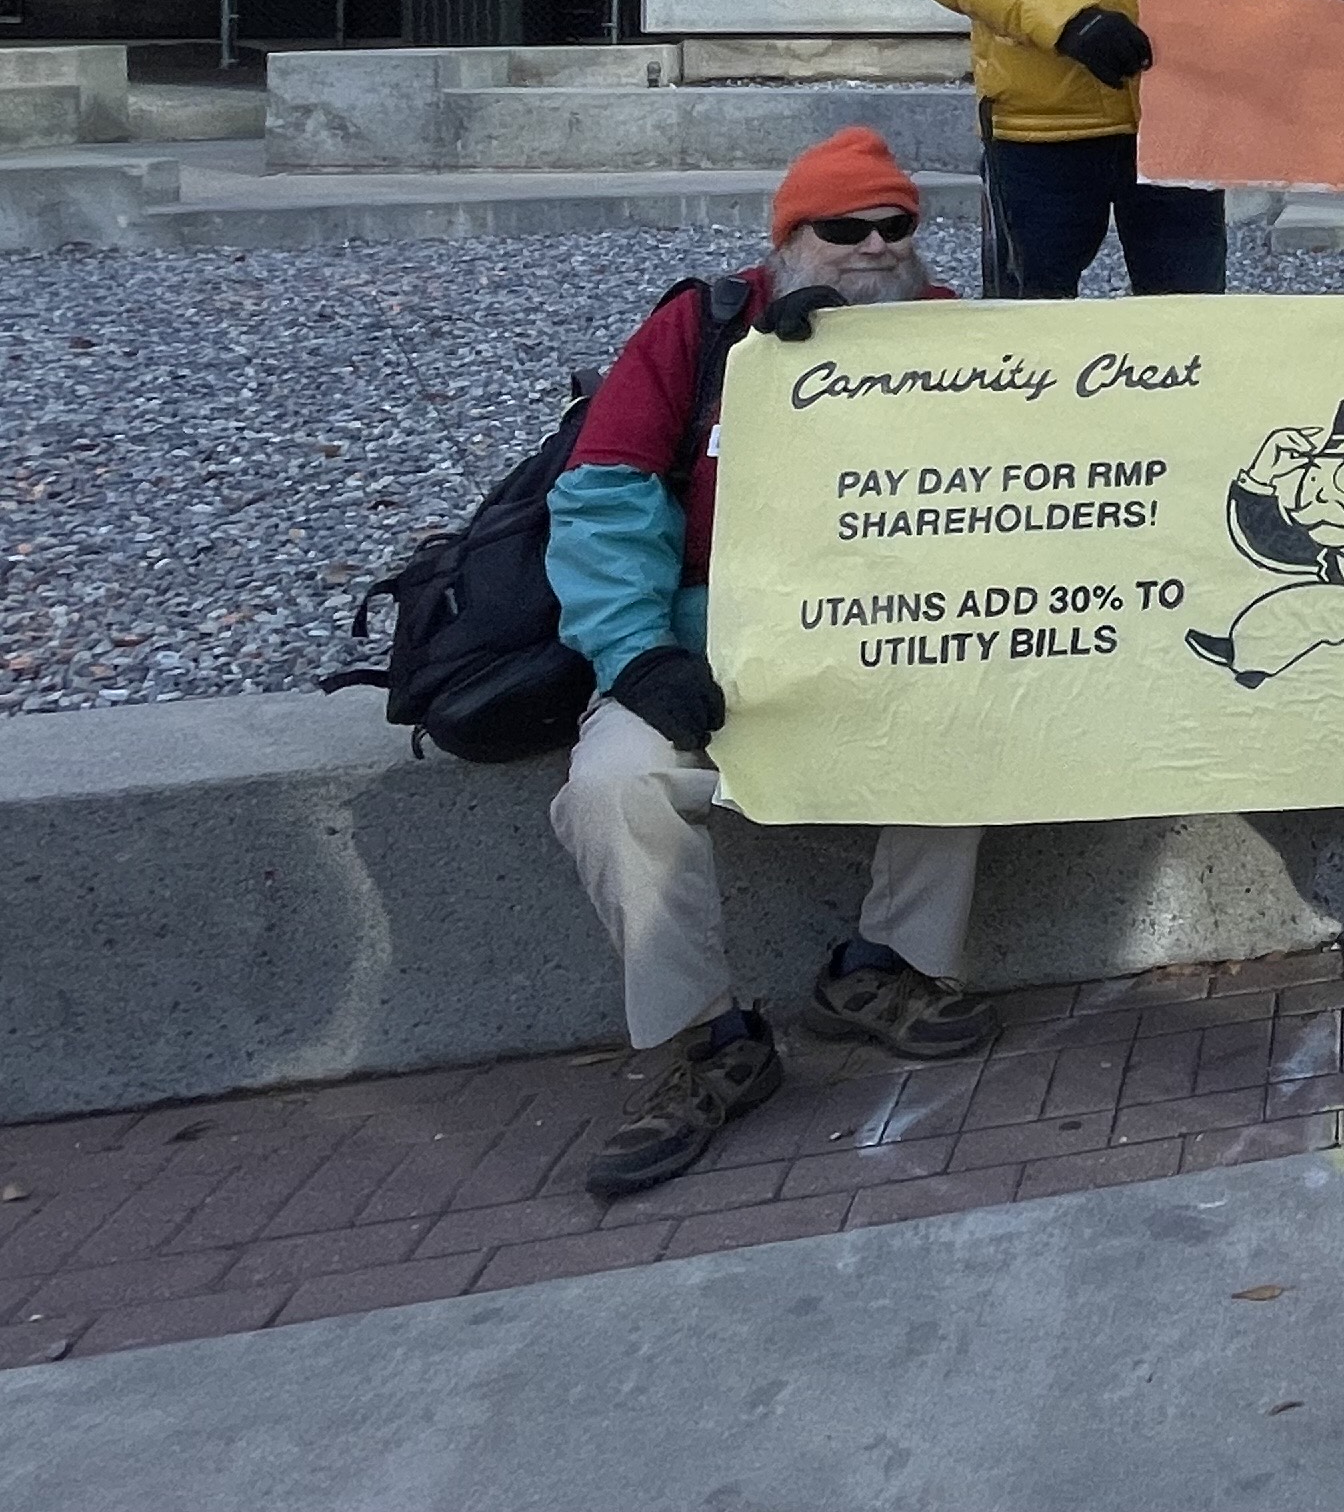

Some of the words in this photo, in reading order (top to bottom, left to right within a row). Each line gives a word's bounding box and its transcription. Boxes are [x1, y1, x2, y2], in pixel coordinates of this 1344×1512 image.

[790, 352, 1057, 411] Community
[1076, 352, 1202, 400] Chest
[836, 469, 906, 499] PAY
[917, 463, 994, 496] DAY
[1002, 461, 1077, 492] FOR
[1085, 459, 1169, 490] RMP
[836, 500, 1158, 541] SHAREHOLDERS!
[800, 591, 946, 630] UTAHNS
[956, 585, 1040, 622] ADD
[1047, 582, 1124, 616] 30%
[1136, 578, 1185, 612] TO
[858, 630, 1003, 668] UTILITY
[1009, 624, 1118, 659] BILLS
